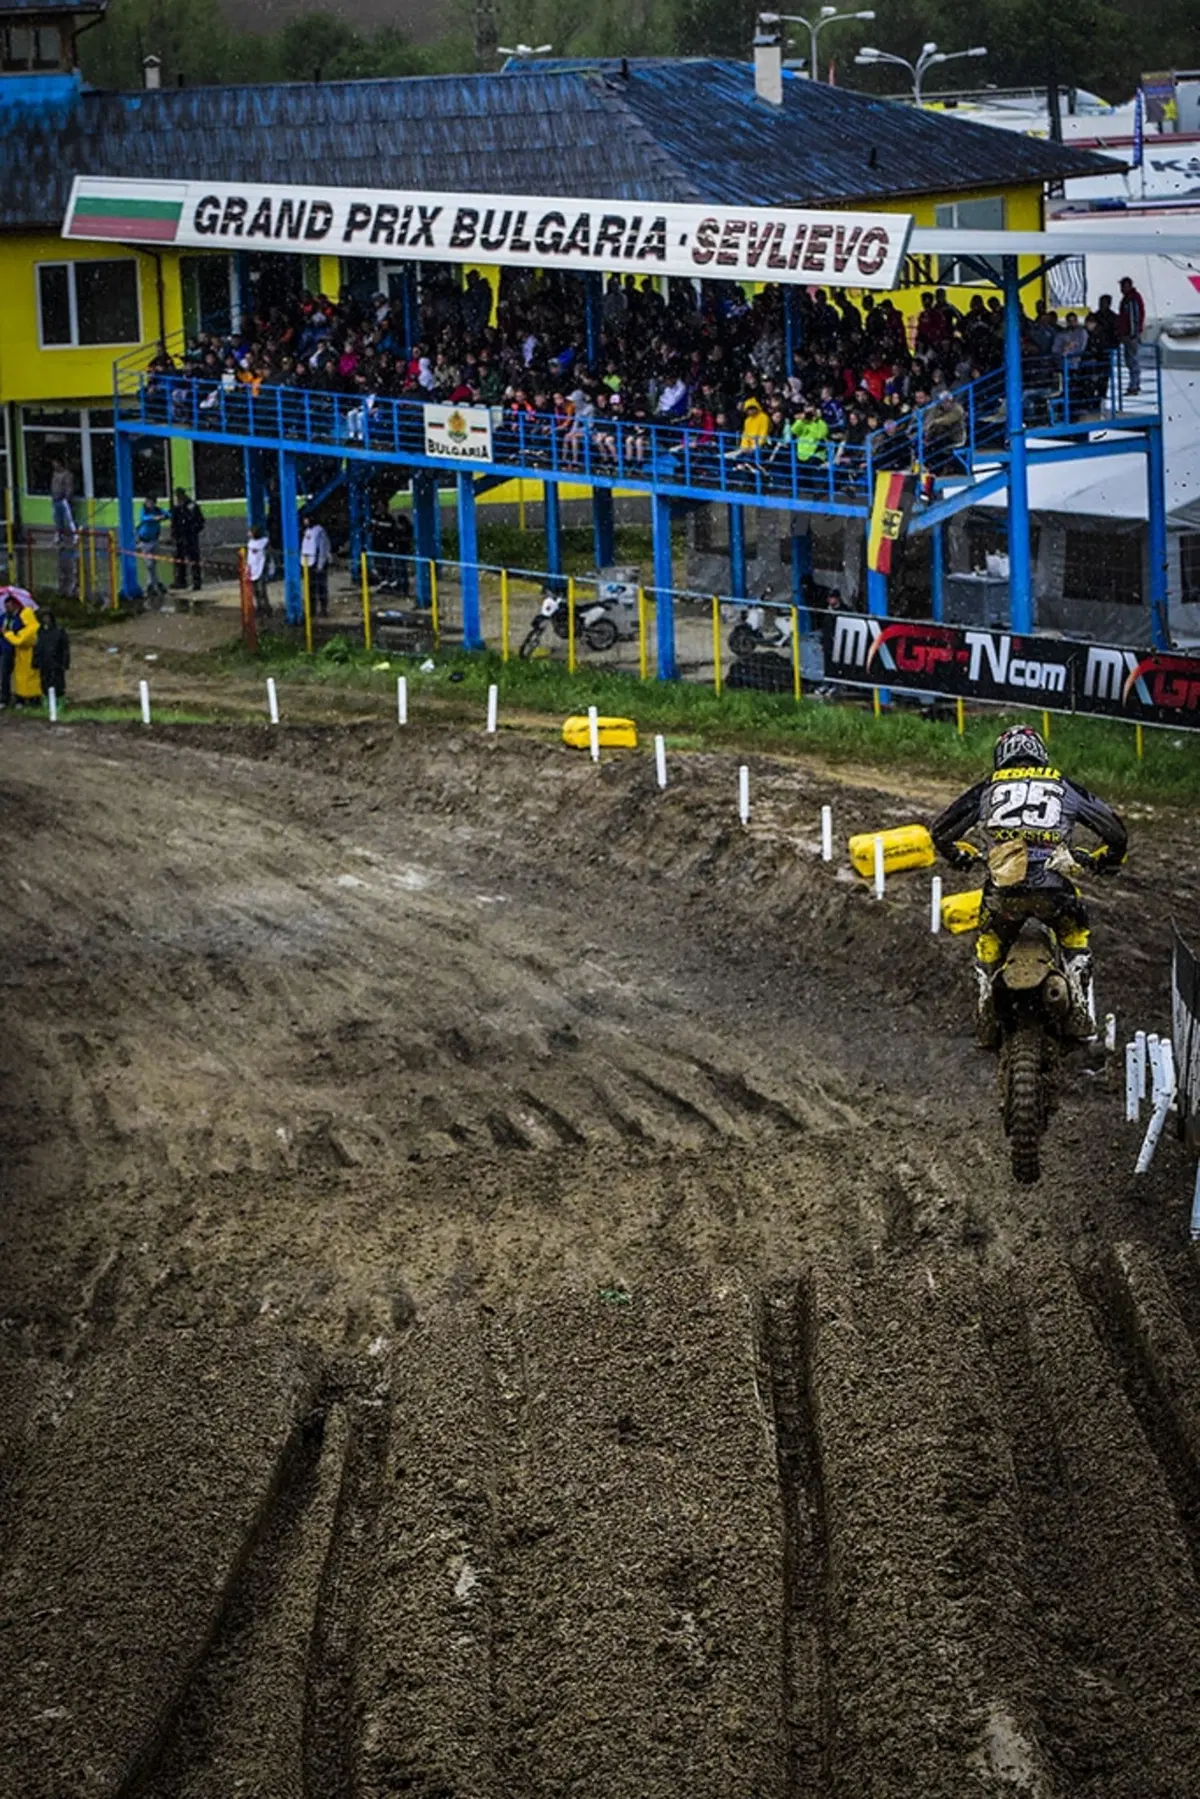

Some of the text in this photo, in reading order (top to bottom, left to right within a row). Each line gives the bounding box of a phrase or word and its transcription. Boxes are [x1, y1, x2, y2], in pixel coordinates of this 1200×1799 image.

[193, 194, 890, 275] GRAND PRIX BULGARIA SEVLIEVO
[428, 438, 490, 459] BULGARIA
[987, 780, 1065, 829] 25
